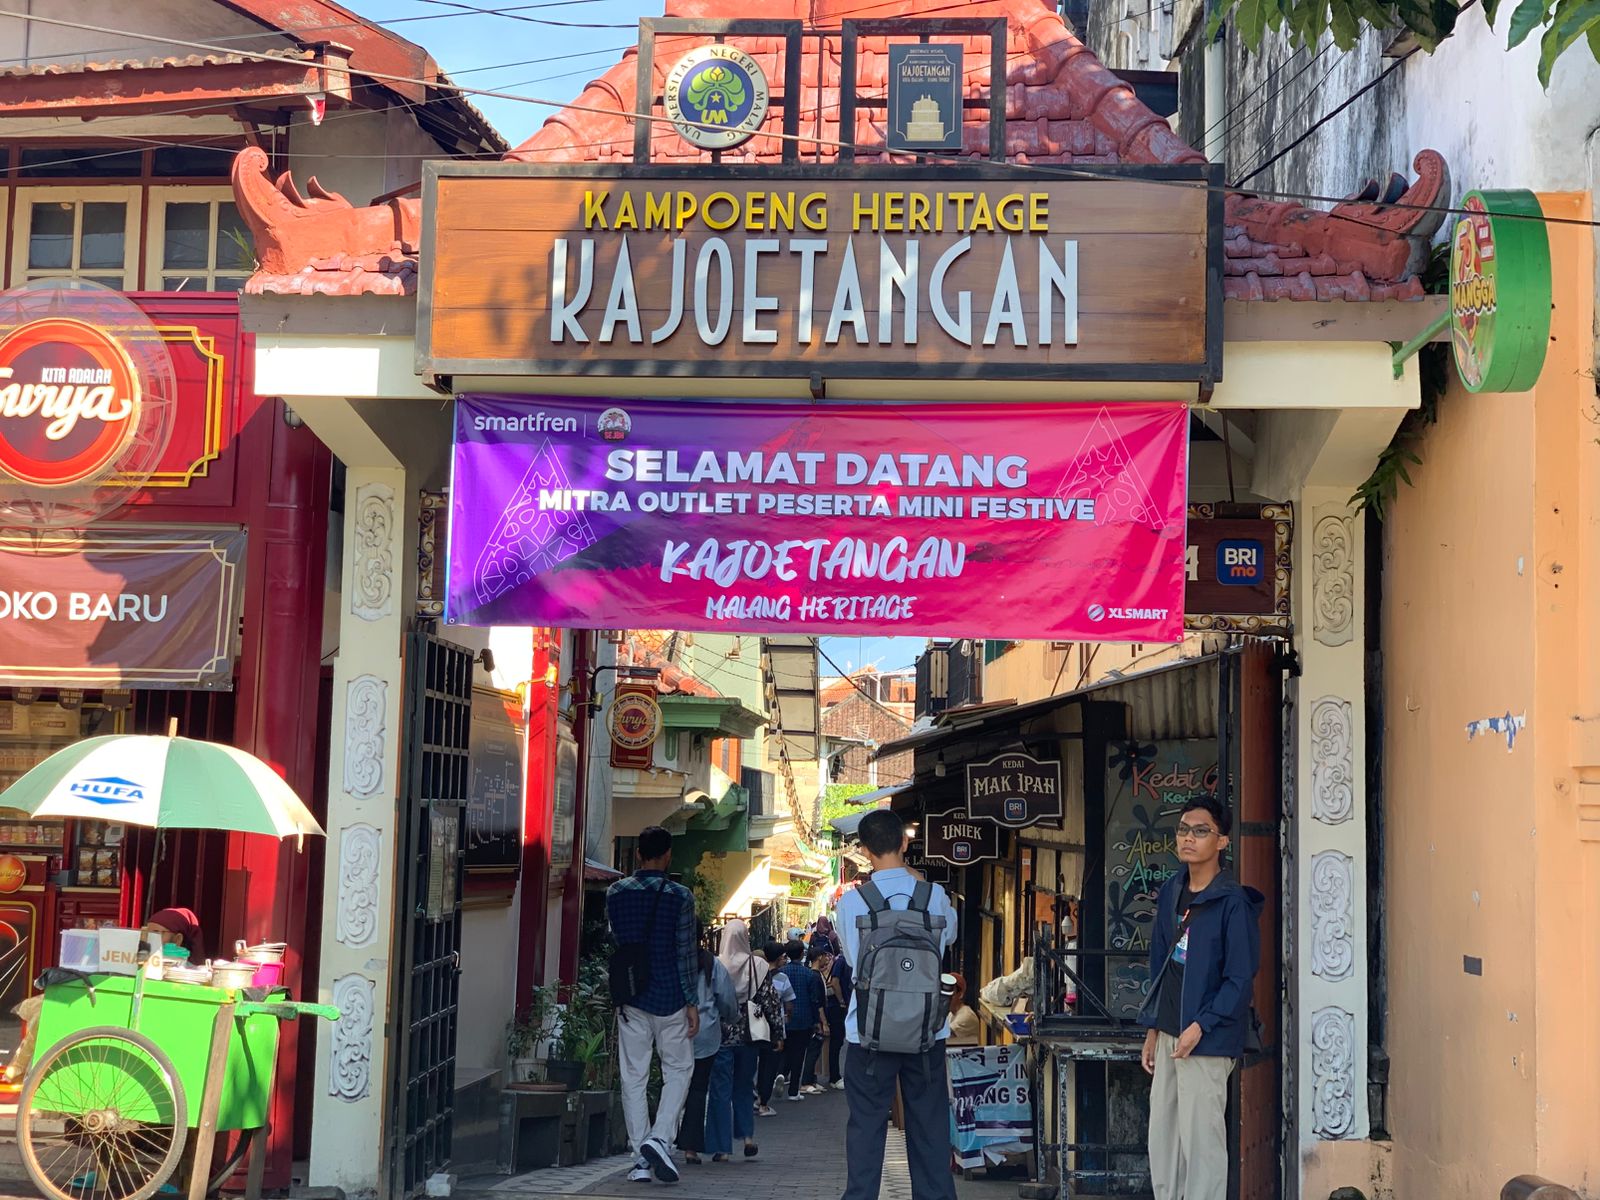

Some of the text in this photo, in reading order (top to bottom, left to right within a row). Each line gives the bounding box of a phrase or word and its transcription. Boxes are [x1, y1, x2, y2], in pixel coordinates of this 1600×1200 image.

[902, 65, 951, 77] KAJOETANGAN
[668, 48, 765, 141] UNVERSITAS NEGERI MALAG
[701, 109, 728, 124] UM
[584, 190, 1049, 232] KAMPOENG HERITAGE
[549, 233, 1079, 347] KAJOETANGAN
[1453, 273, 1497, 314] MANGGA
[42, 367, 113, 385] KITA ADALAH
[473, 412, 577, 433] smartfren
[604, 450, 1028, 489] SELAMAT DATANG
[538, 489, 1096, 520] MITRA OUTLET PESERTA MINI FESTIVE
[660, 536, 966, 588] KAJOETANGAN
[1224, 547, 1257, 566] BRI
[1230, 566, 1256, 577] mo
[69, 592, 168, 623] BARU
[705, 595, 918, 622] MALANG HERITAGE
[1108, 607, 1169, 620] XLSMART
[1002, 760, 1025, 769] KEDAI
[70, 783, 144, 800] HUFA
[973, 773, 1056, 797] MAK IPAH
[1132, 762, 1201, 800] Kedai
[1008, 803, 1022, 811] BRI
[942, 824, 982, 840] UNIEK
[1126, 832, 1182, 868] Anek
[102, 950, 161, 967] JENAG
